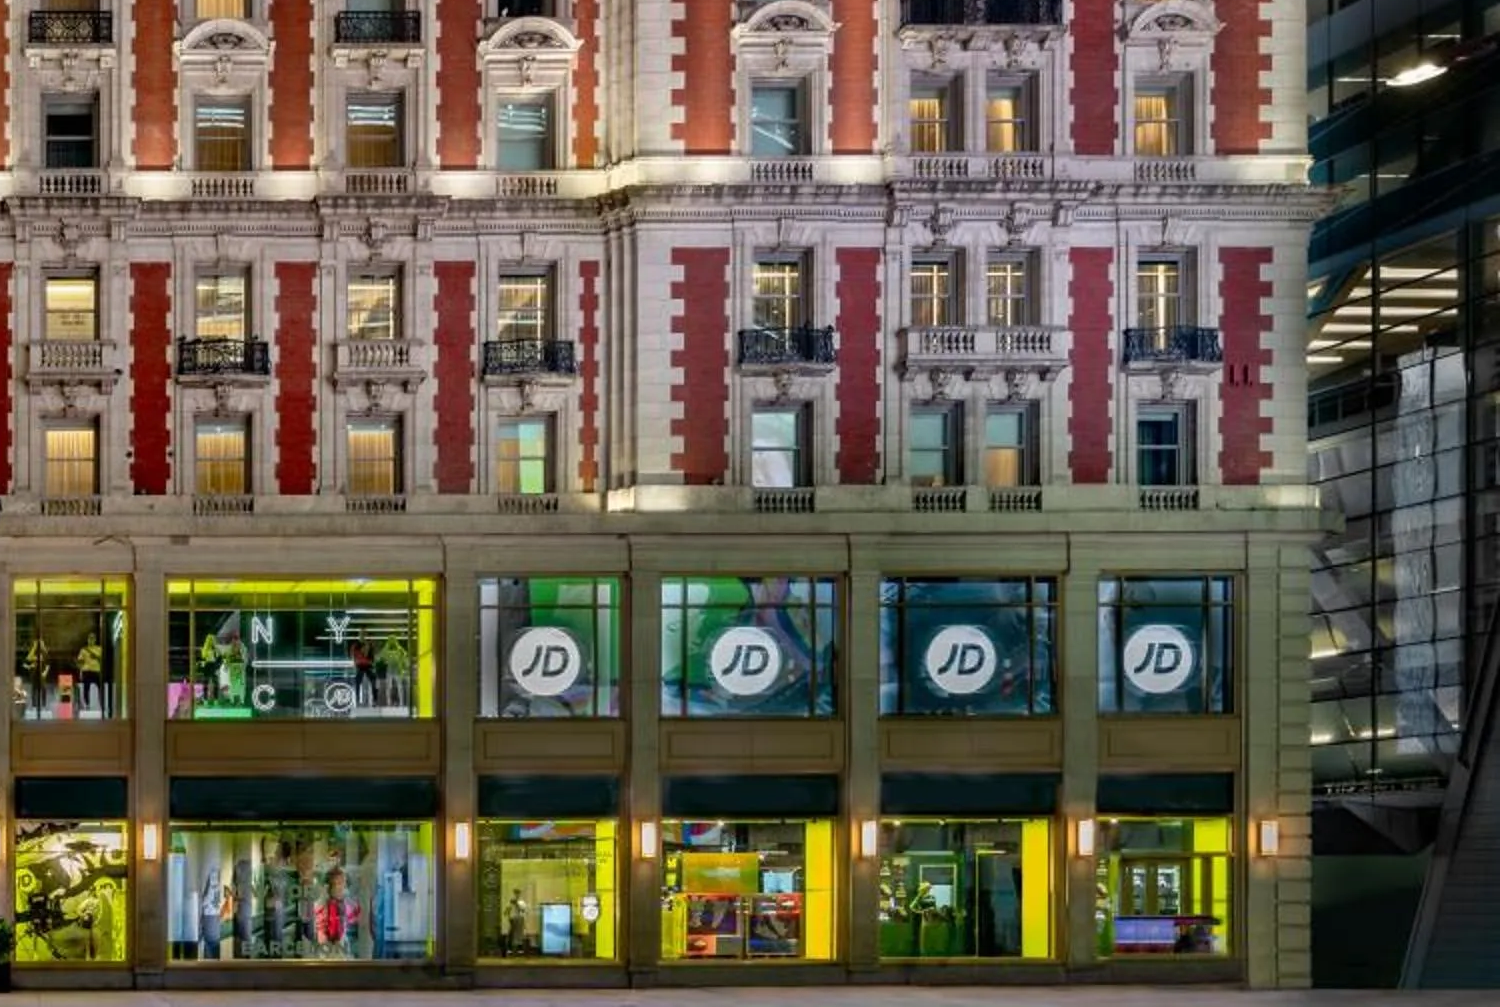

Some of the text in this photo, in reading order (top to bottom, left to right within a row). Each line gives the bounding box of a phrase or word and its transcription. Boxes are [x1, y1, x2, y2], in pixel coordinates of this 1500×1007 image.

[521, 645, 570, 677] JD
[721, 644, 769, 676] JD
[937, 643, 985, 675] JD
[1133, 642, 1182, 674] JD
